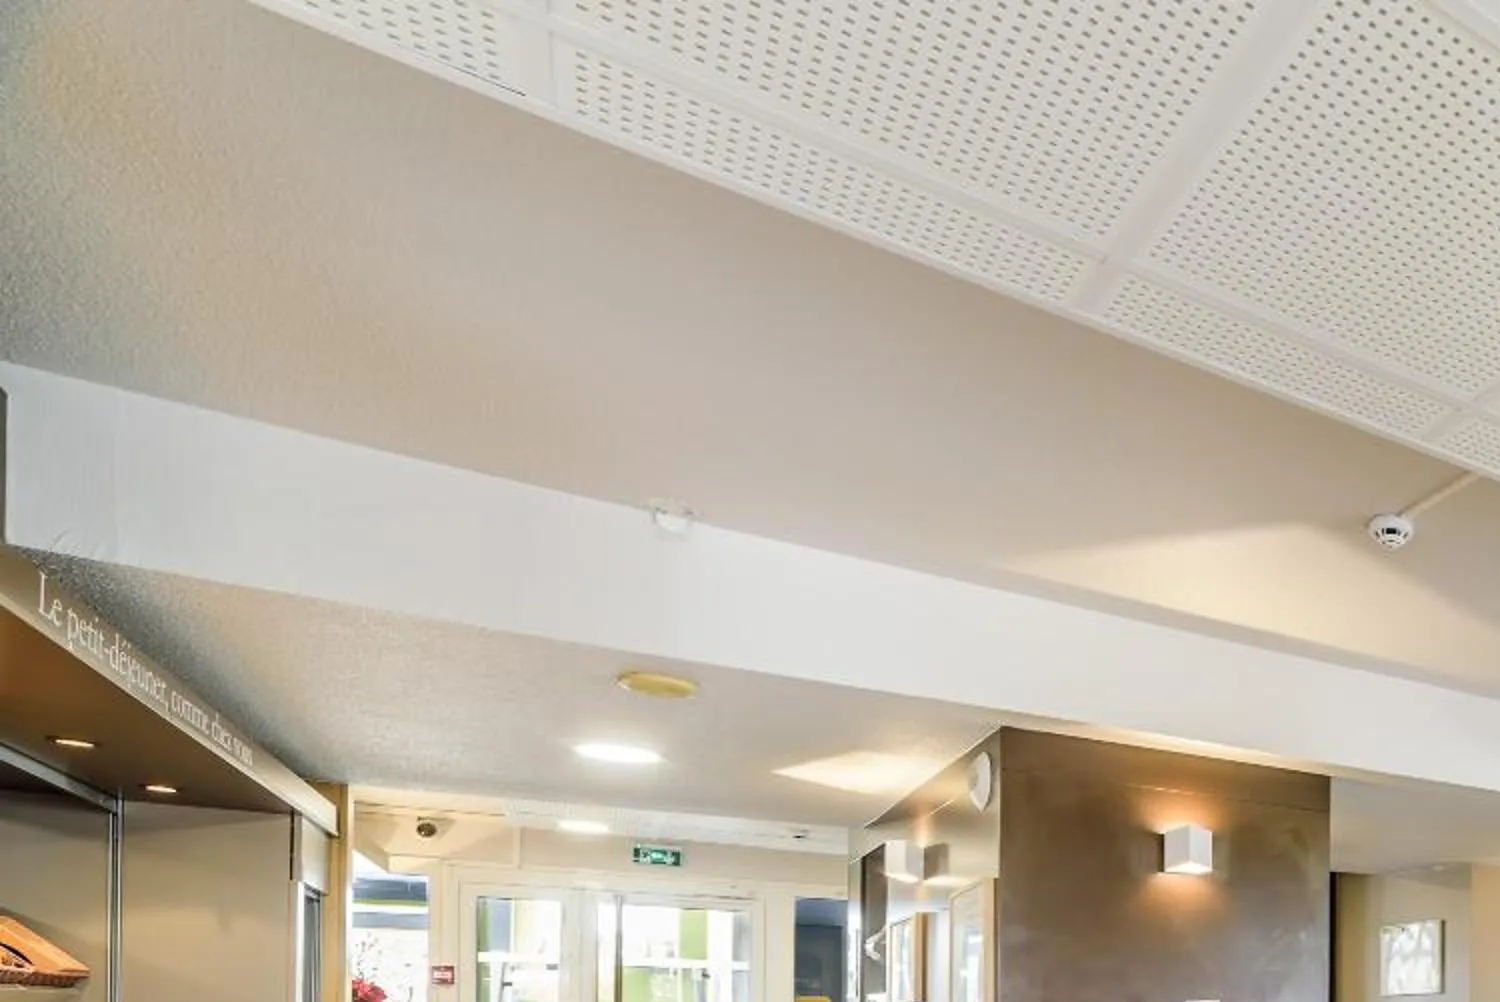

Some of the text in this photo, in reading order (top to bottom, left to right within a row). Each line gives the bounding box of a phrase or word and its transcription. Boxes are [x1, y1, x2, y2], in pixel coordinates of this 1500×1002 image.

[38, 571, 63, 627] Le
[67, 608, 169, 712] petit-déjeuner,
[171, 690, 209, 735] comme
